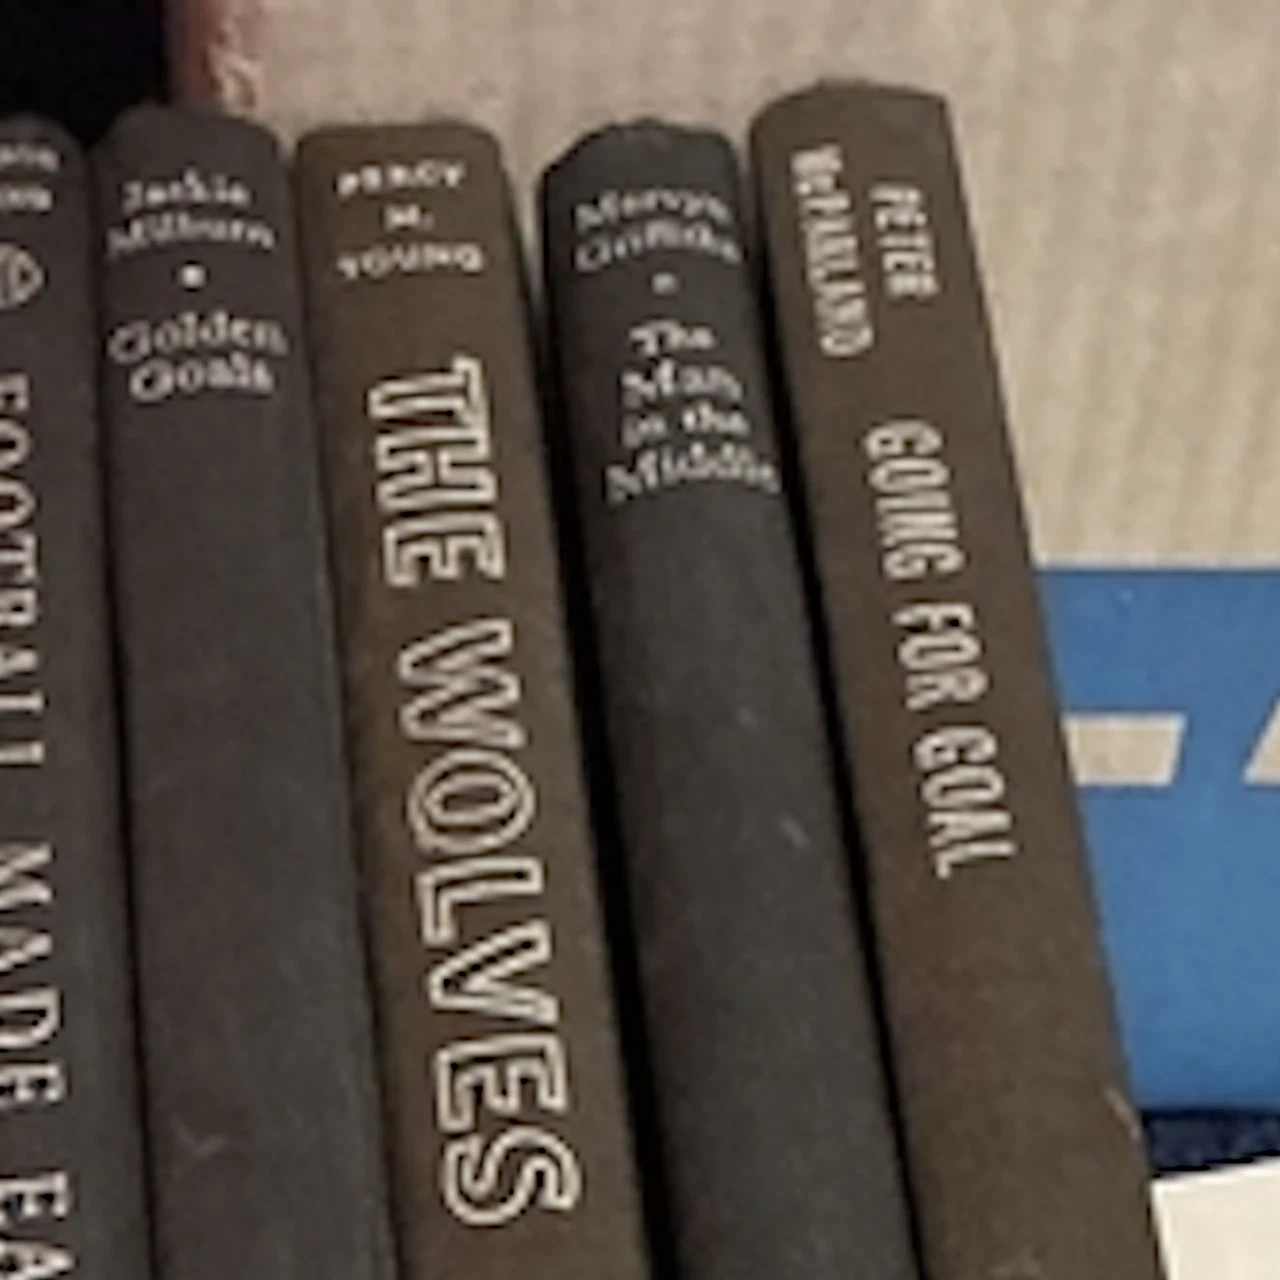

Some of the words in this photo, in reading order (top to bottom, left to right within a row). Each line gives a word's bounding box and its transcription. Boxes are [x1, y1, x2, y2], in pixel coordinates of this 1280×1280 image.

[337, 160, 466, 196] PERCY
[337, 242, 484, 281] YOUNG
[873, 180, 940, 300] PETER
[108, 312, 289, 363] Golden
[129, 353, 275, 402] Goals
[368, 355, 505, 588] THE
[862, 418, 966, 581] GOING
[891, 600, 990, 711] FOR
[914, 722, 1016, 880] GOAL
[400, 618, 582, 1226] WOLVES
